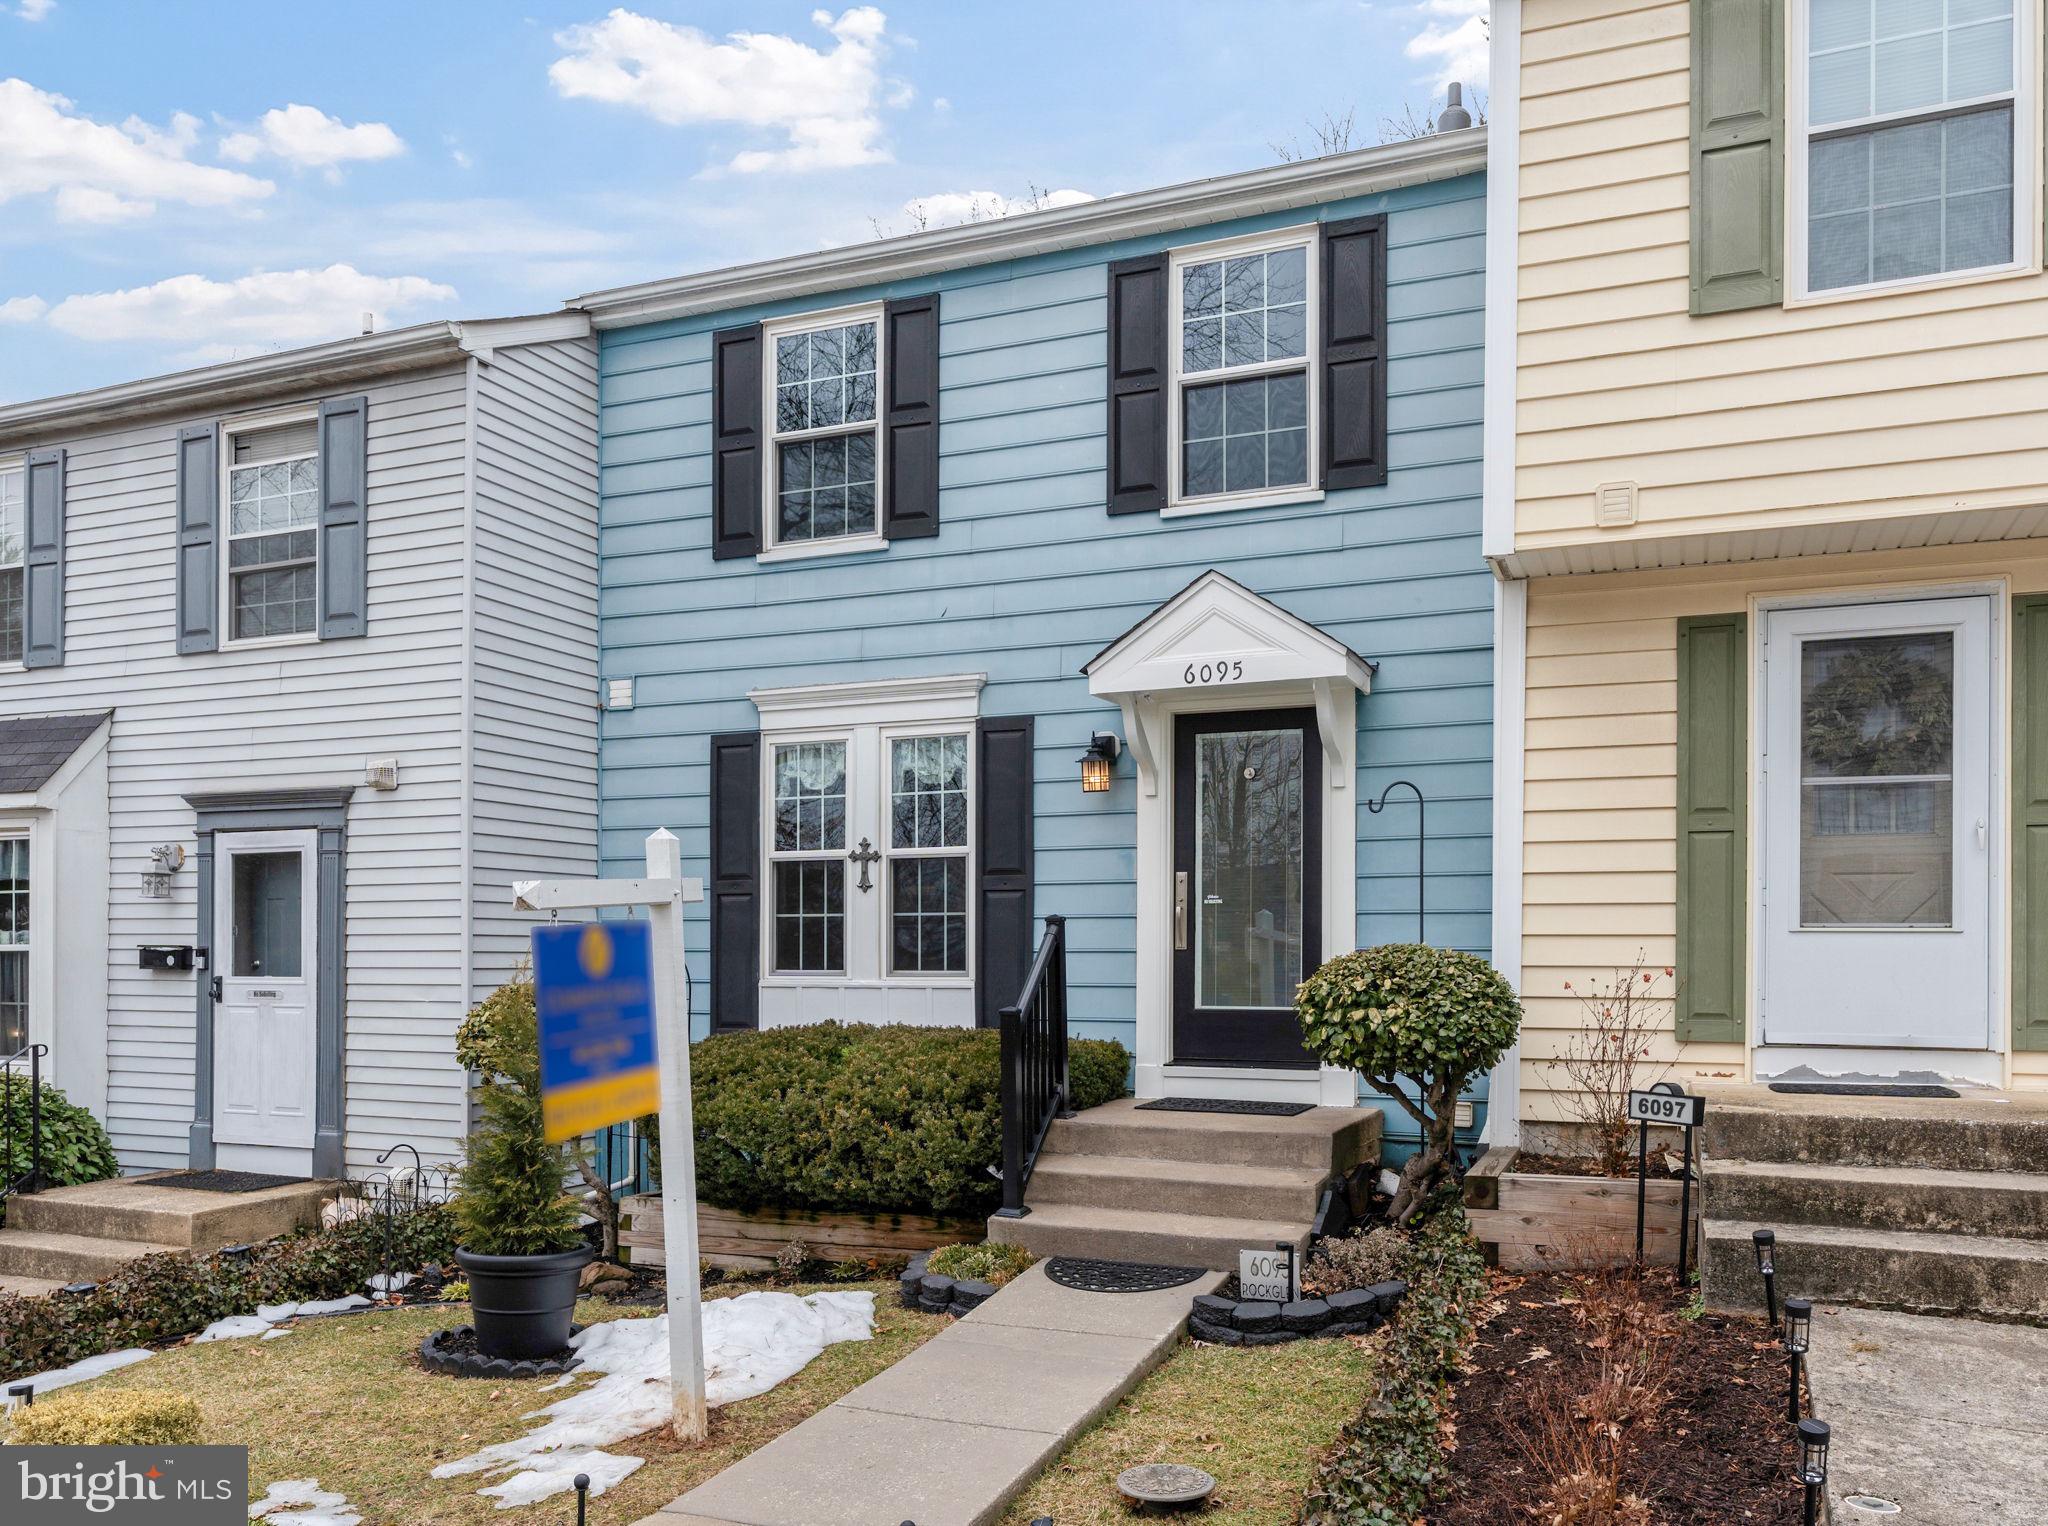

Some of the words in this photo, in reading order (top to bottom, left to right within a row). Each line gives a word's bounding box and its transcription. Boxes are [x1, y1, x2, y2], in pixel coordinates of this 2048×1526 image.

[1184, 661, 1242, 684] 6095
[1638, 1097, 1686, 1118] 6097
[1242, 1282, 1299, 1298] ROCKGLN
